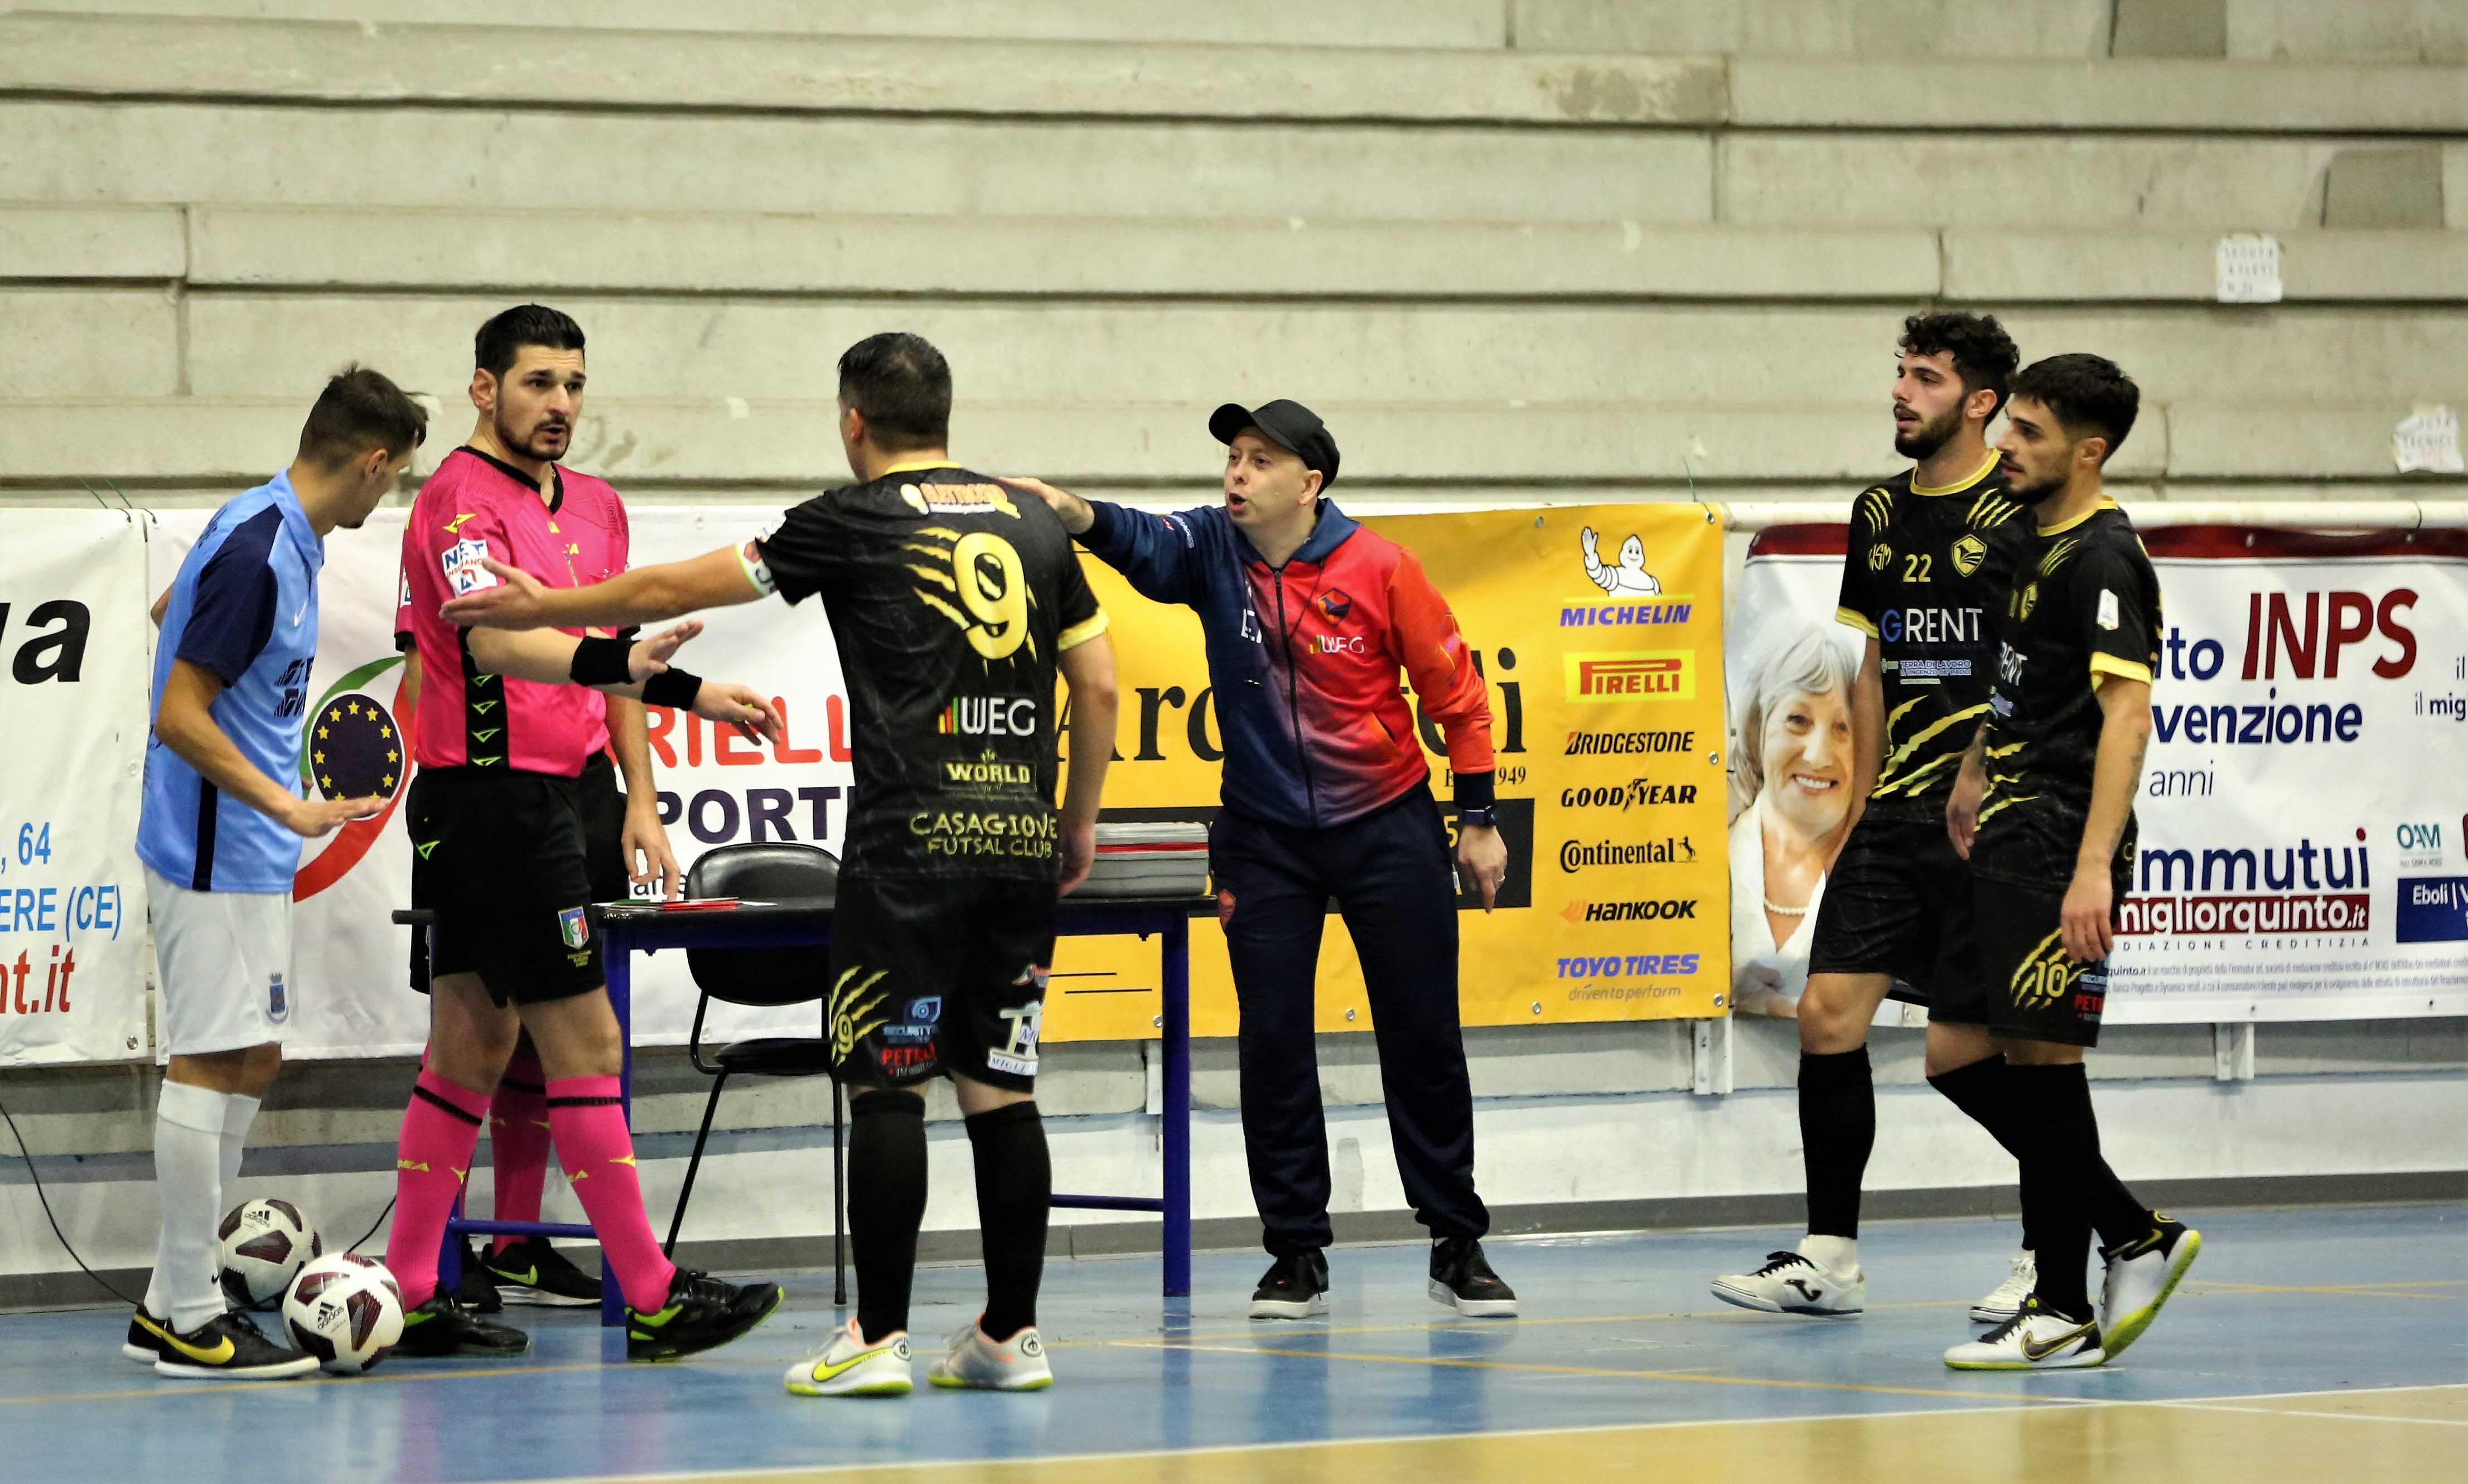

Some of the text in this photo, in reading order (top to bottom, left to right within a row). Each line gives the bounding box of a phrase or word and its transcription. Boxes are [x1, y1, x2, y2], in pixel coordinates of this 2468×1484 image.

[1902, 554, 1932, 582] 22
[953, 531, 1028, 660] 9
[1560, 605, 1692, 626] MICHELIN
[1881, 608, 1983, 642] GRENT
[0, 600, 90, 685] a
[2155, 588, 2419, 680] to INPS
[1580, 659, 1682, 695] PIRELLI
[1901, 660, 1924, 669] TERRA
[1926, 660, 1935, 669] DI
[1936, 660, 1972, 669] LAVORO
[2456, 656, 2465, 680] il
[961, 697, 1036, 736] WEG
[2151, 687, 2363, 745] venzione
[2415, 690, 2468, 721] il mig
[604, 694, 852, 768] RIELL
[1564, 731, 1696, 755] BRIDGESTONE
[946, 763, 1031, 783] WORLD
[2148, 760, 2214, 797] anni
[617, 786, 856, 844] PORT
[910, 813, 1058, 839] CASAGIOVE
[18, 822, 51, 865] 64
[928, 837, 1052, 858] FUTSAL CLUB
[1560, 838, 1674, 873] Continental
[2127, 826, 2370, 892] mmutui
[2412, 883, 2449, 906] Eboli
[65, 884, 121, 942] (CE)
[2245, 937, 2369, 949] CREDITIZIA
[1557, 954, 1699, 978] TOYO TIRES
[2035, 960, 2068, 998] 10
[1568, 985, 1681, 1003] driven to perform
[837, 1013, 854, 1053] 9
